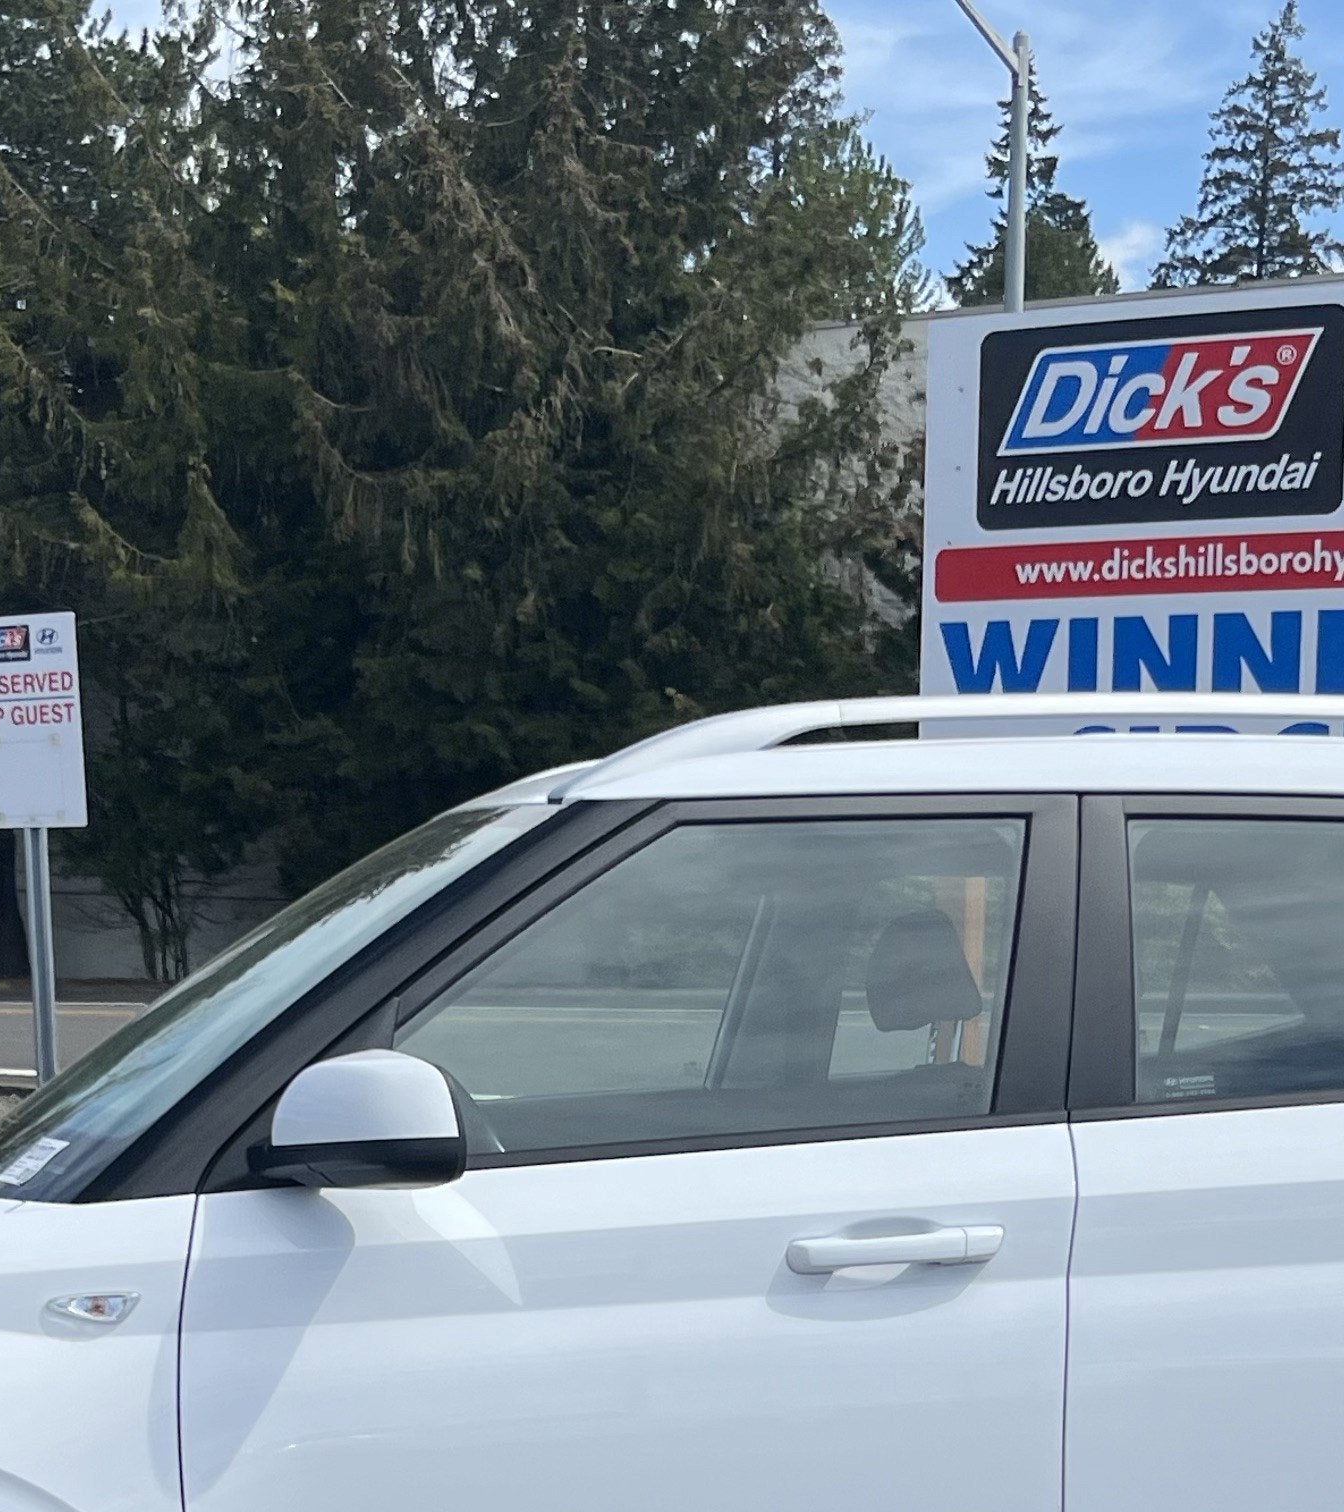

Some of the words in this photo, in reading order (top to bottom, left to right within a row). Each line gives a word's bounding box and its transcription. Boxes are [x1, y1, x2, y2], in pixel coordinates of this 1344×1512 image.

[1021, 346, 1280, 439] Dick's
[989, 464, 1154, 506] Hillsboro
[1158, 452, 1322, 505] Hyundai
[11, 703, 75, 726] GUEST
